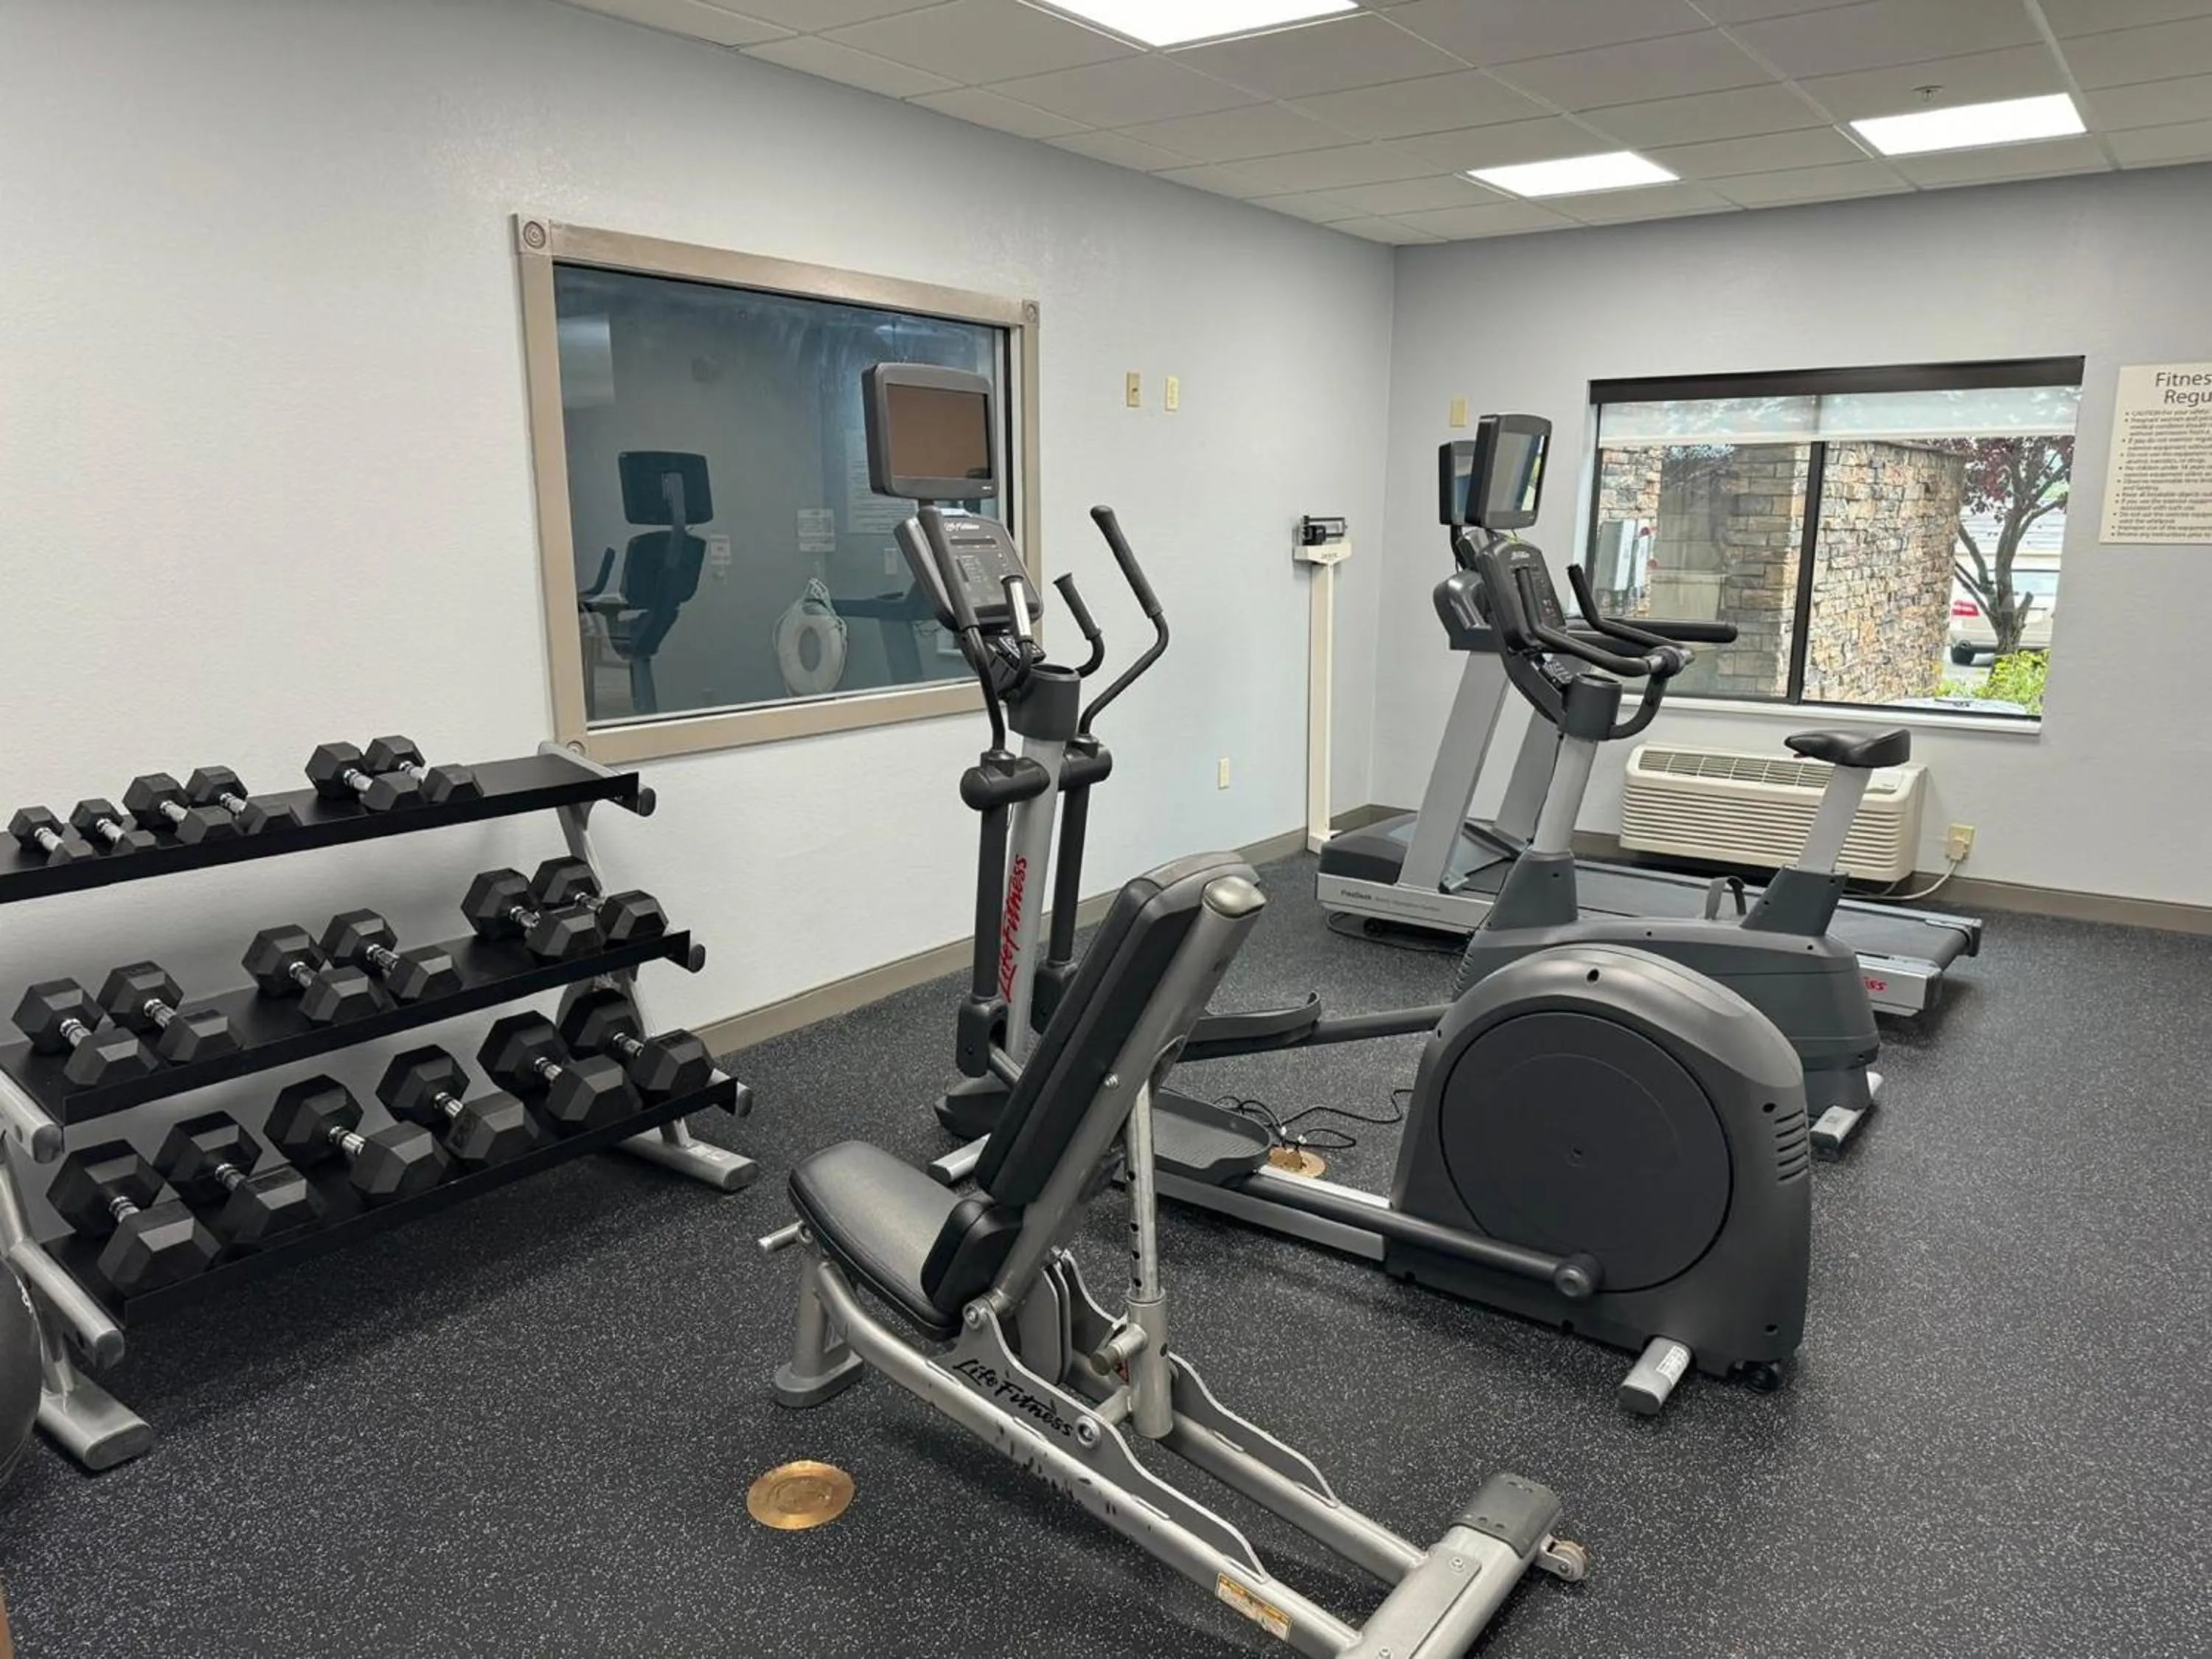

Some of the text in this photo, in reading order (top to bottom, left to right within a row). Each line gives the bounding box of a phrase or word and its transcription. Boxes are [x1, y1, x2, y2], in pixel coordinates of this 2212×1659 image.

[2155, 372, 2212, 387] Fitnes
[2164, 389, 2212, 408] Regu
[1001, 853, 1027, 952] Fitness
[952, 1359, 1074, 1438] Life Fitness
